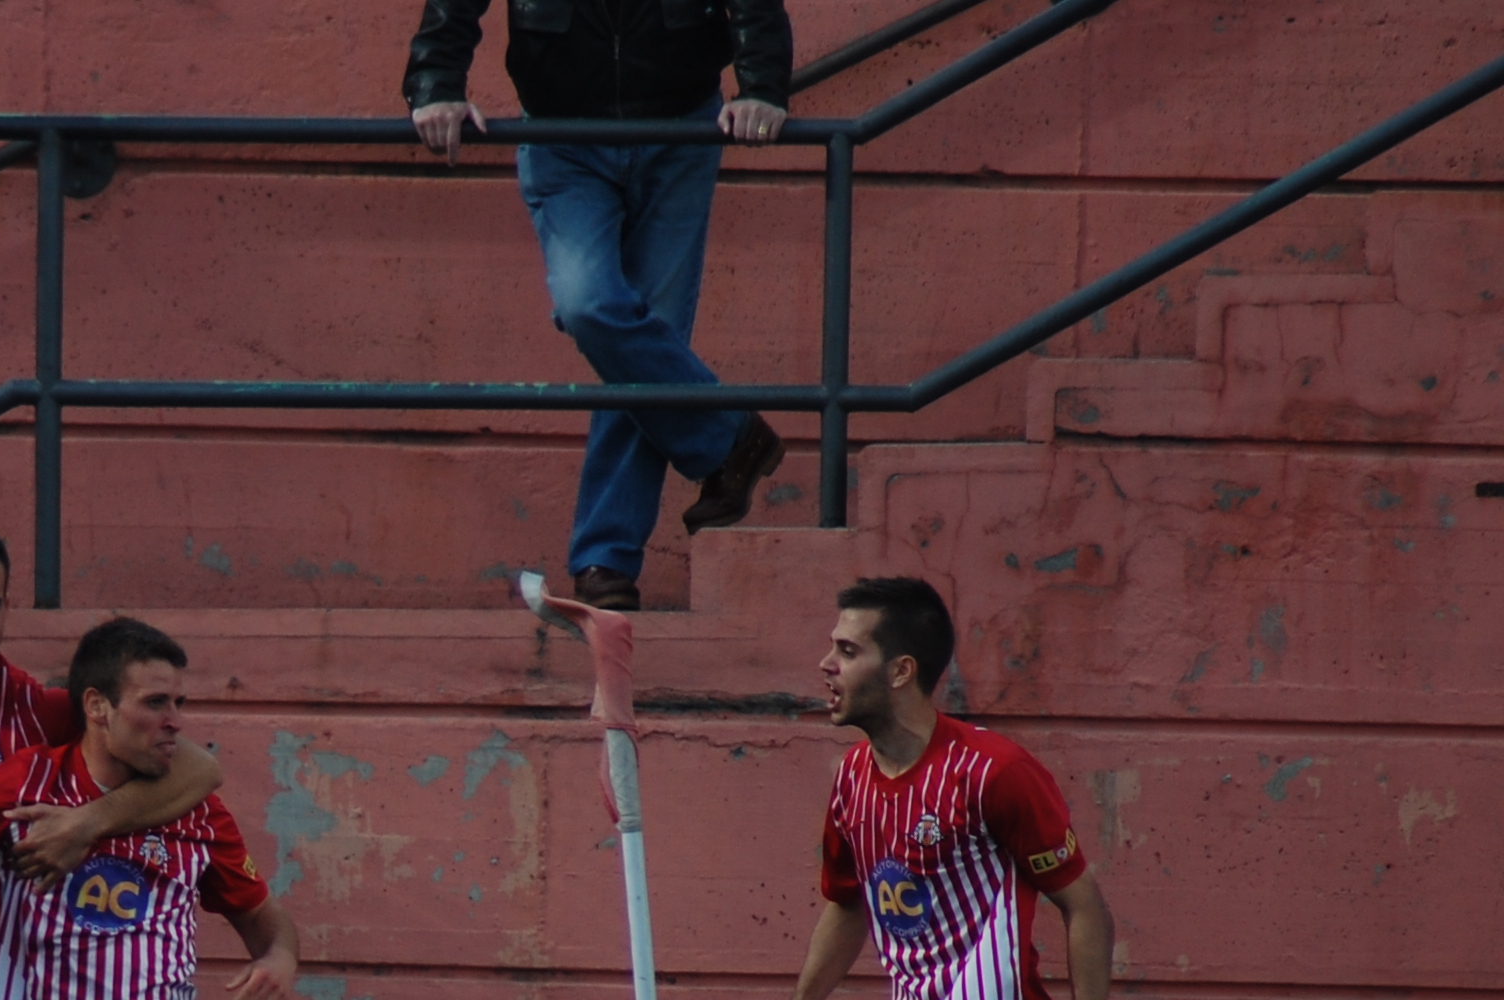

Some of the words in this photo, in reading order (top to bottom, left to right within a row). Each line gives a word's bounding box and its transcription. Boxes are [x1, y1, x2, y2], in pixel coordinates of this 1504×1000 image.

[1031, 855, 1055, 871] EL
[76, 874, 141, 920] AC
[877, 880, 924, 916] AC
